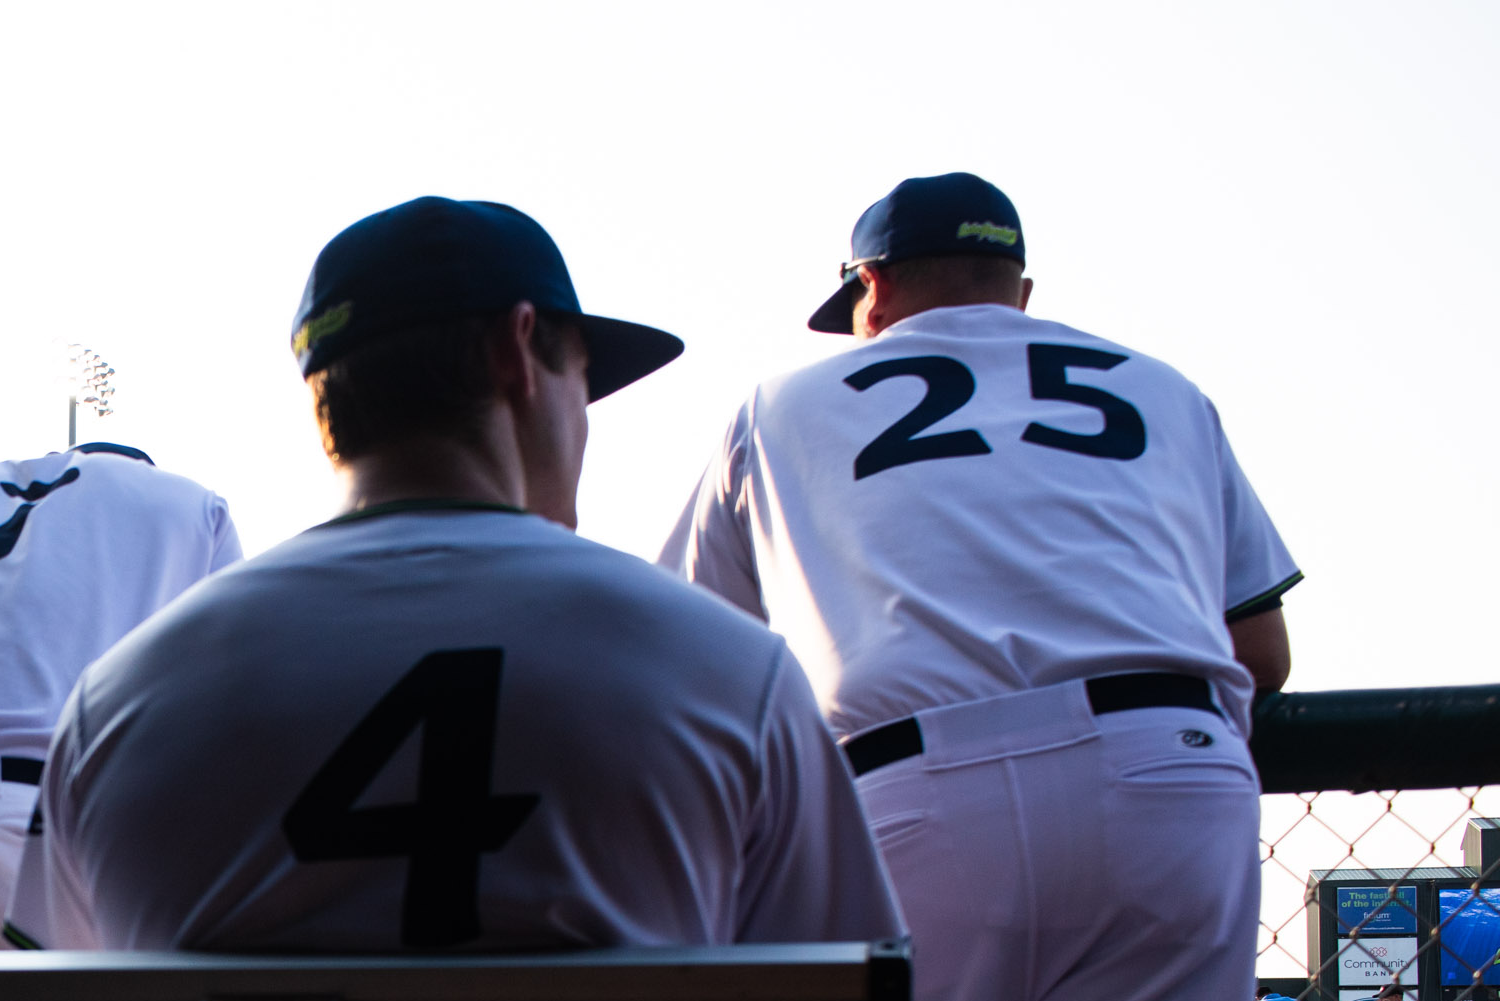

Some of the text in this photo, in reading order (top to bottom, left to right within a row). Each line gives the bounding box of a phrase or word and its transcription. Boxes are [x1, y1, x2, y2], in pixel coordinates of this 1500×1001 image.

[843, 343, 1147, 481] 25
[281, 646, 542, 949] 4
[1341, 900, 1351, 908] of
